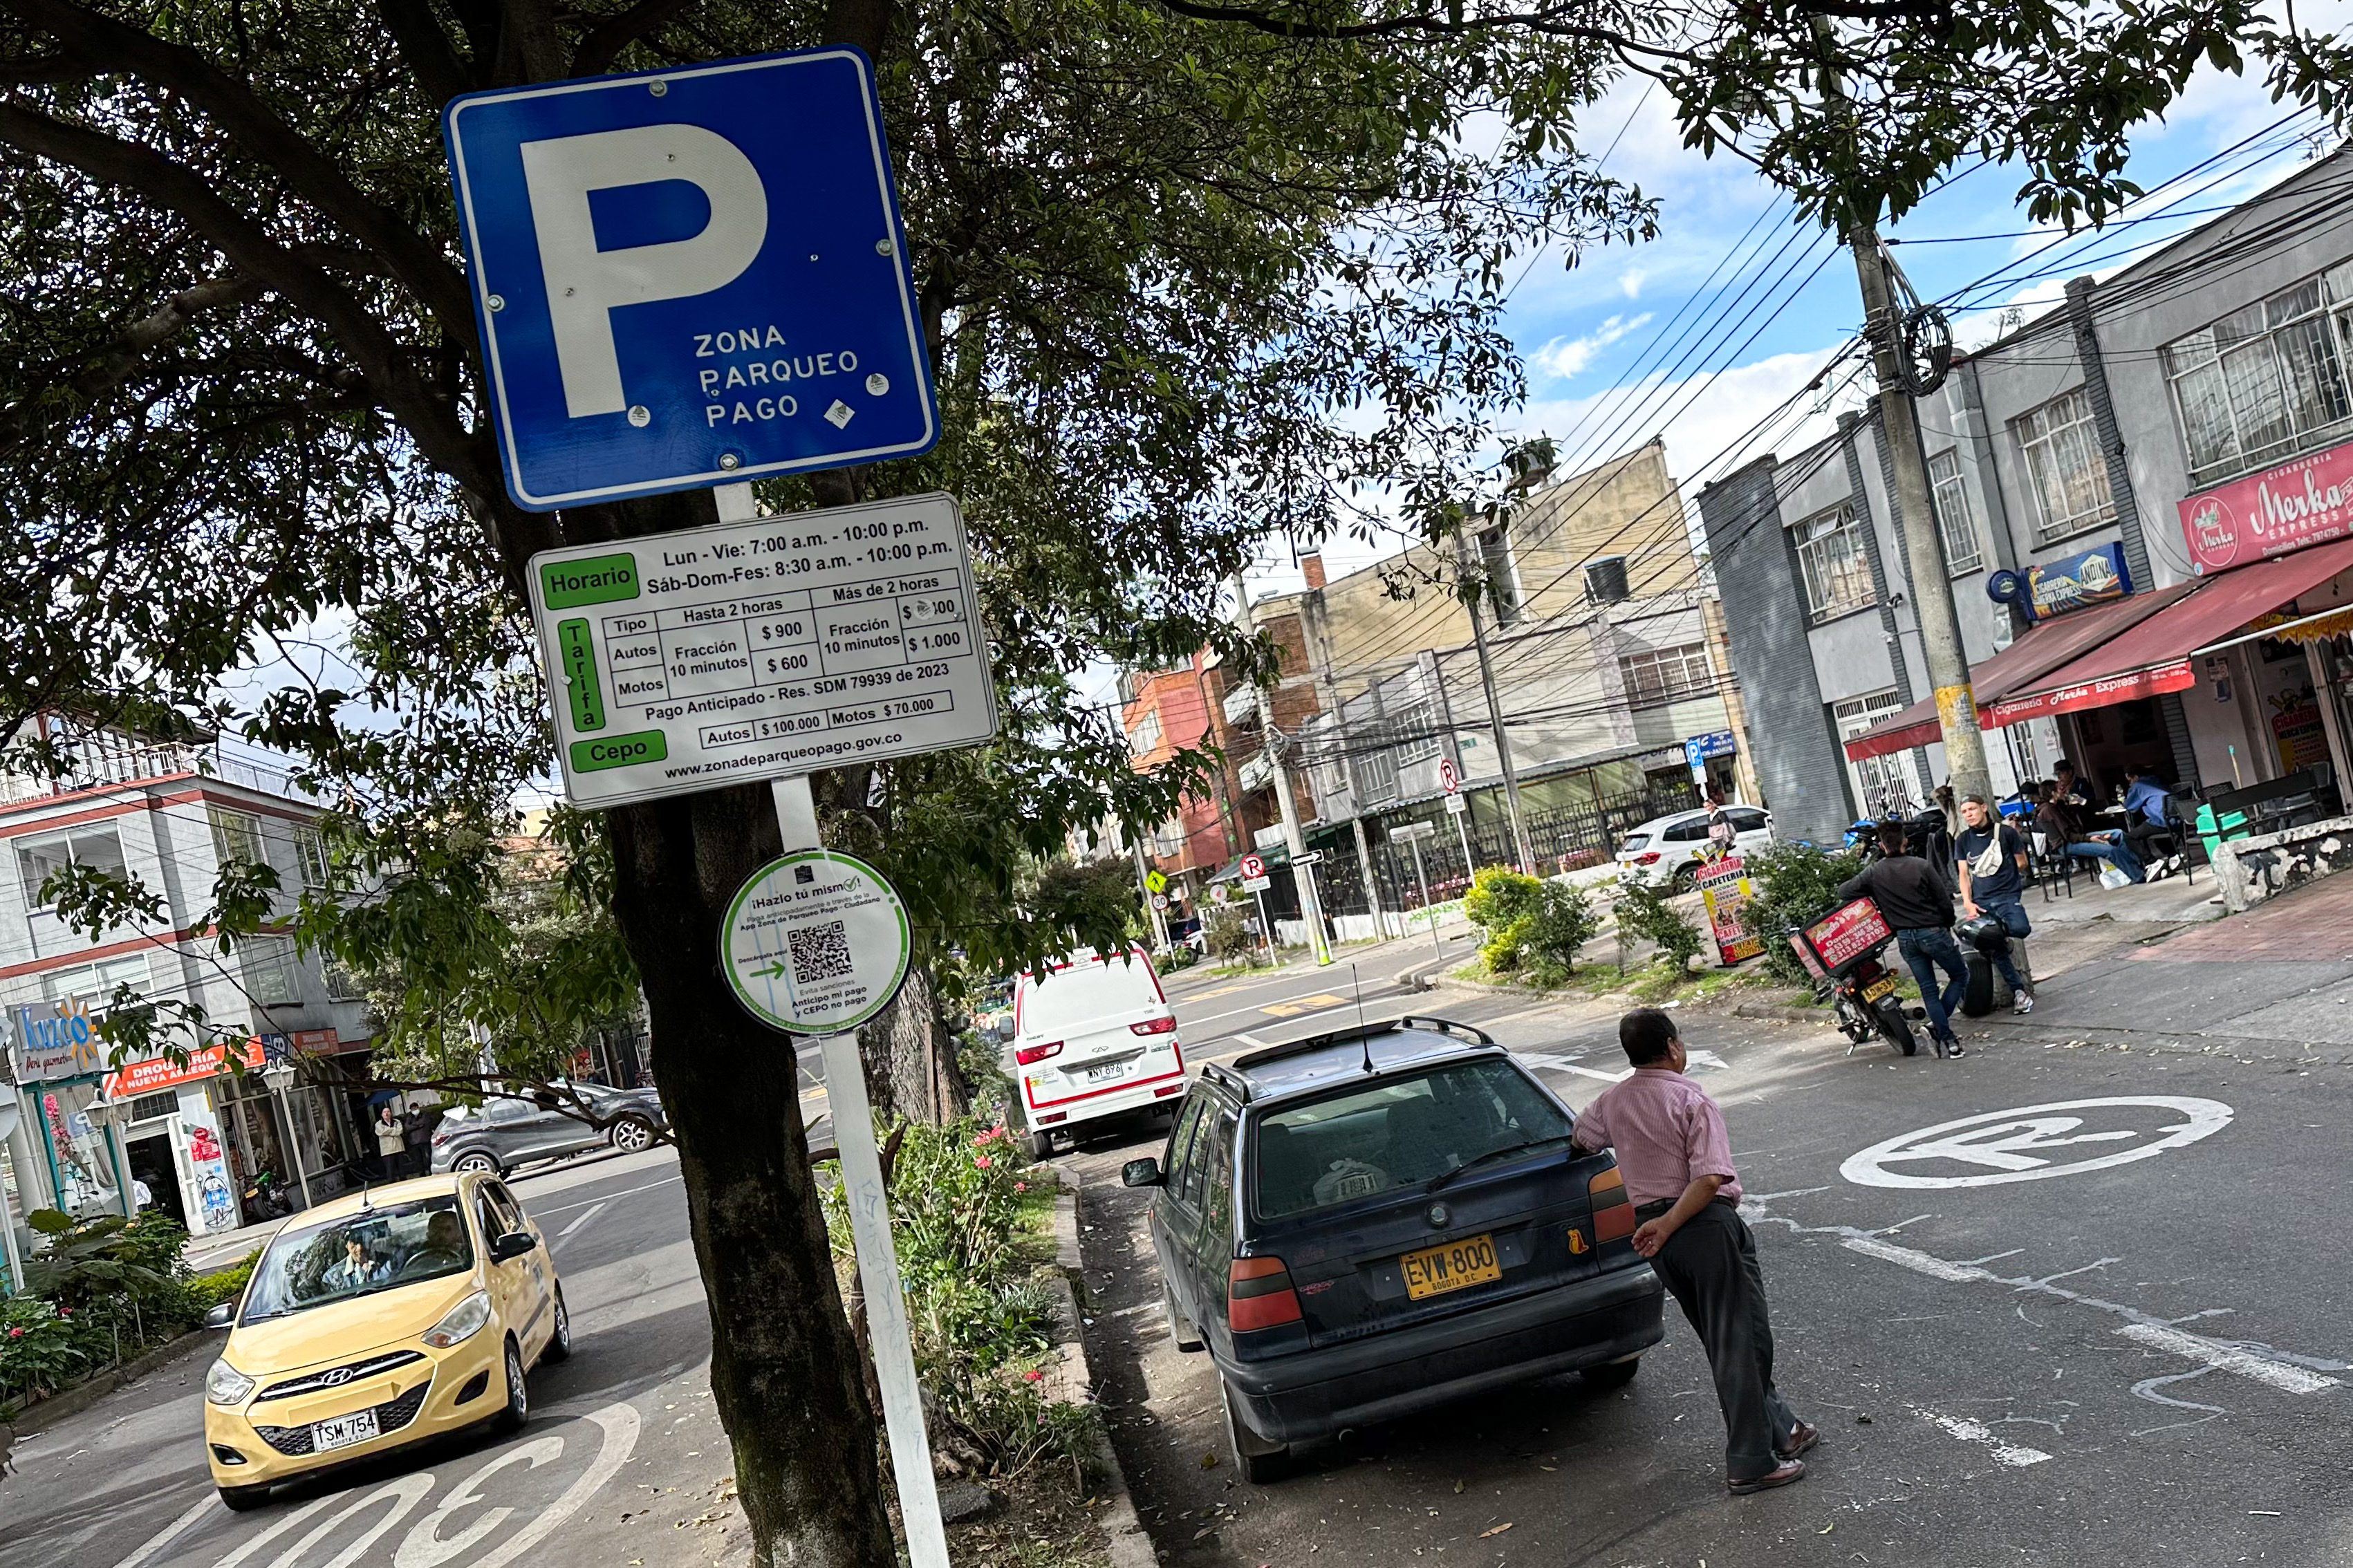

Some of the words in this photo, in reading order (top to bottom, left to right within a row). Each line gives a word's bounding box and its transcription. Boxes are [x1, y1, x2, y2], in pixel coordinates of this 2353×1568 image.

[520, 124, 768, 419] P
[694, 325, 786, 357] ZONA
[699, 351, 857, 393] PARQUEO
[706, 395, 798, 427] PAGO
[2268, 454, 2332, 480] CIGARRERIA
[2249, 468, 2345, 535] Merka
[2269, 510, 2339, 540] EXPRESS
[663, 551, 697, 567] Lun
[712, 544, 745, 559] Vie:
[750, 536, 786, 554] 7:00
[792, 533, 828, 548] a.m.
[843, 523, 887, 542] 10:00
[893, 519, 929, 538] p.m.
[2199, 526, 2234, 552] Merka
[647, 566, 770, 594] Sáb-Dom-Fes:
[775, 558, 810, 577] 8:30
[816, 554, 851, 570] a.m.
[867, 544, 911, 563] 10:00
[916, 541, 952, 559] p.m.
[2081, 560, 2112, 586] ANDINA
[550, 567, 631, 593] Horario
[833, 588, 862, 601] Más
[866, 584, 883, 596] de
[886, 581, 895, 594] 2
[899, 576, 939, 592] horas
[2056, 584, 2083, 601] EXPRESS
[683, 607, 725, 622] Hasta
[729, 604, 738, 616] 2
[742, 598, 783, 614] horas
[902, 606, 912, 620] $
[613, 619, 647, 633] Tipo
[762, 626, 771, 641] $
[775, 622, 802, 637] 900
[830, 618, 889, 636] Fracción
[613, 645, 657, 661] Autos
[675, 640, 736, 660] Fracción
[824, 642, 840, 655] 10
[844, 633, 900, 652] minutos
[909, 637, 918, 653] $
[921, 631, 960, 650] 1.000
[670, 664, 686, 678] 10
[690, 656, 748, 675] minutos
[768, 658, 776, 674] $
[781, 655, 808, 671] 600
[618, 679, 664, 696] Motos
[645, 704, 683, 720] Pago
[687, 692, 765, 714] Anticipado
[778, 687, 810, 700] Res.
[814, 678, 847, 695] SDM
[850, 671, 892, 689] 79939
[895, 669, 913, 682] de
[916, 663, 949, 680] 2023
[2050, 688, 2088, 705] Merka
[2095, 675, 2139, 693] Express
[707, 728, 751, 745] Autos
[761, 724, 770, 737] $
[772, 716, 820, 734] 100.000
[833, 709, 875, 725] Motos
[884, 704, 892, 718] $
[894, 698, 933, 715] 70.000
[590, 741, 647, 762] Cepo
[665, 734, 902, 778] www.zonadeparqueopago.gov.co
[795, 888, 808, 900] tú
[1155, 897, 1166, 907] 30
[741, 923, 756, 931] App
[789, 910, 819, 920] Parqueo
[844, 897, 880, 908] Ciudadano
[767, 902, 825, 919] anticipadamente
[1826, 918, 1872, 947] Domicilios
[1836, 946, 1851, 958] 313
[792, 995, 829, 1009] Anticipo
[832, 991, 842, 1000] mi
[845, 986, 866, 998] pago
[799, 987, 819, 996] Evita
[820, 979, 855, 991] sanciones
[803, 1003, 828, 1015] CEPO
[845, 996, 866, 1007] pago
[14, 1007, 88, 1052] Kuzco
[1105, 1062, 1121, 1076] 896
[127, 1074, 167, 1089] NUEVA
[1405, 1253, 1449, 1286] EVW
[1452, 1242, 1494, 1274] 800
[1431, 1277, 1460, 1291] BOGOTA
[315, 1423, 344, 1444] TSM
[346, 1414, 375, 1435] 754
